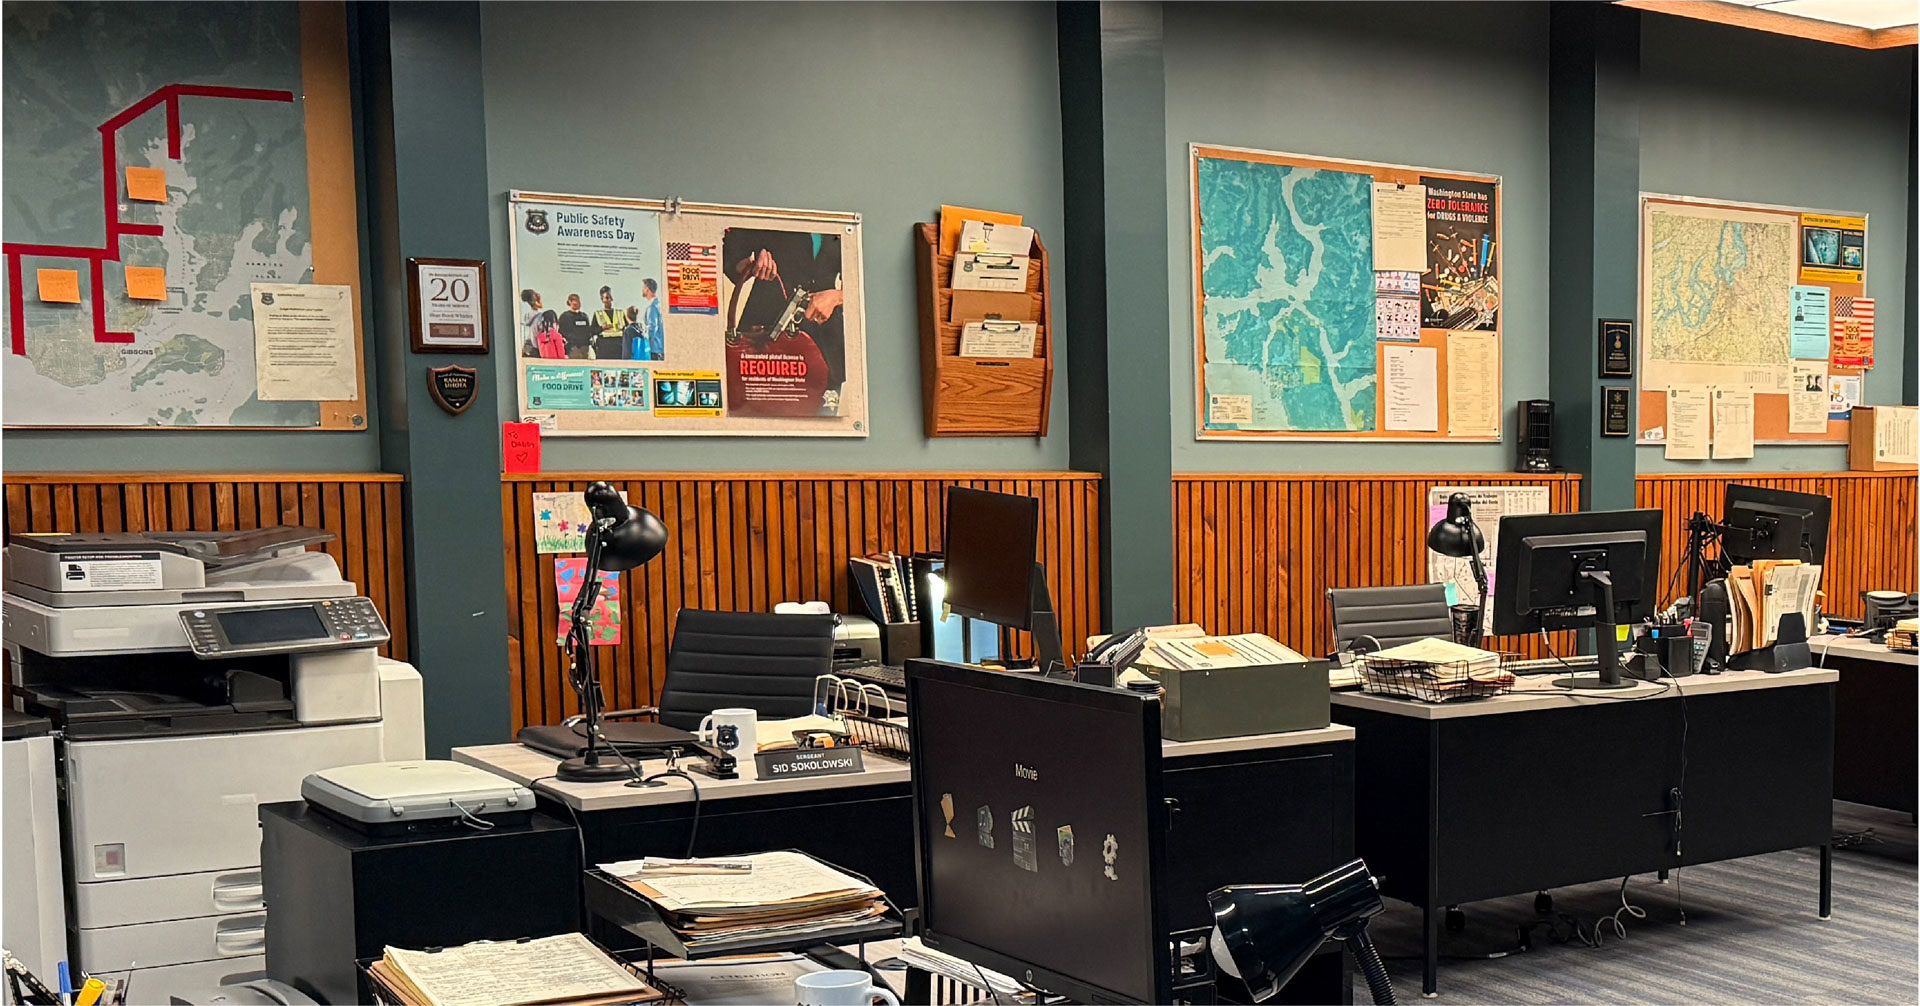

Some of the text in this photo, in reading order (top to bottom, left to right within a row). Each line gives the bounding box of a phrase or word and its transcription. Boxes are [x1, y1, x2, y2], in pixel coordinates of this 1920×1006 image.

[1428, 187, 1488, 201] Washington State has
[1427, 198, 1489, 213] ZERO TOLERANCE
[556, 211, 625, 228] Public Safety
[1427, 211, 1436, 220] for
[1436, 211, 1456, 221] DRUGS
[1462, 213, 1489, 224] VIOLENCE
[557, 226, 635, 242] Awareness Day
[430, 277, 470, 303] 20
[121, 348, 154, 356] GIBSONS
[740, 360, 807, 376] REQUIRED
[542, 383, 562, 391] FOOD
[796, 752, 825, 760] SERGEANT
[772, 758, 853, 773] SID SOKOLOWSKI
[1015, 763, 1038, 781] Movie
[710, 972, 786, 980] ATTENTION
